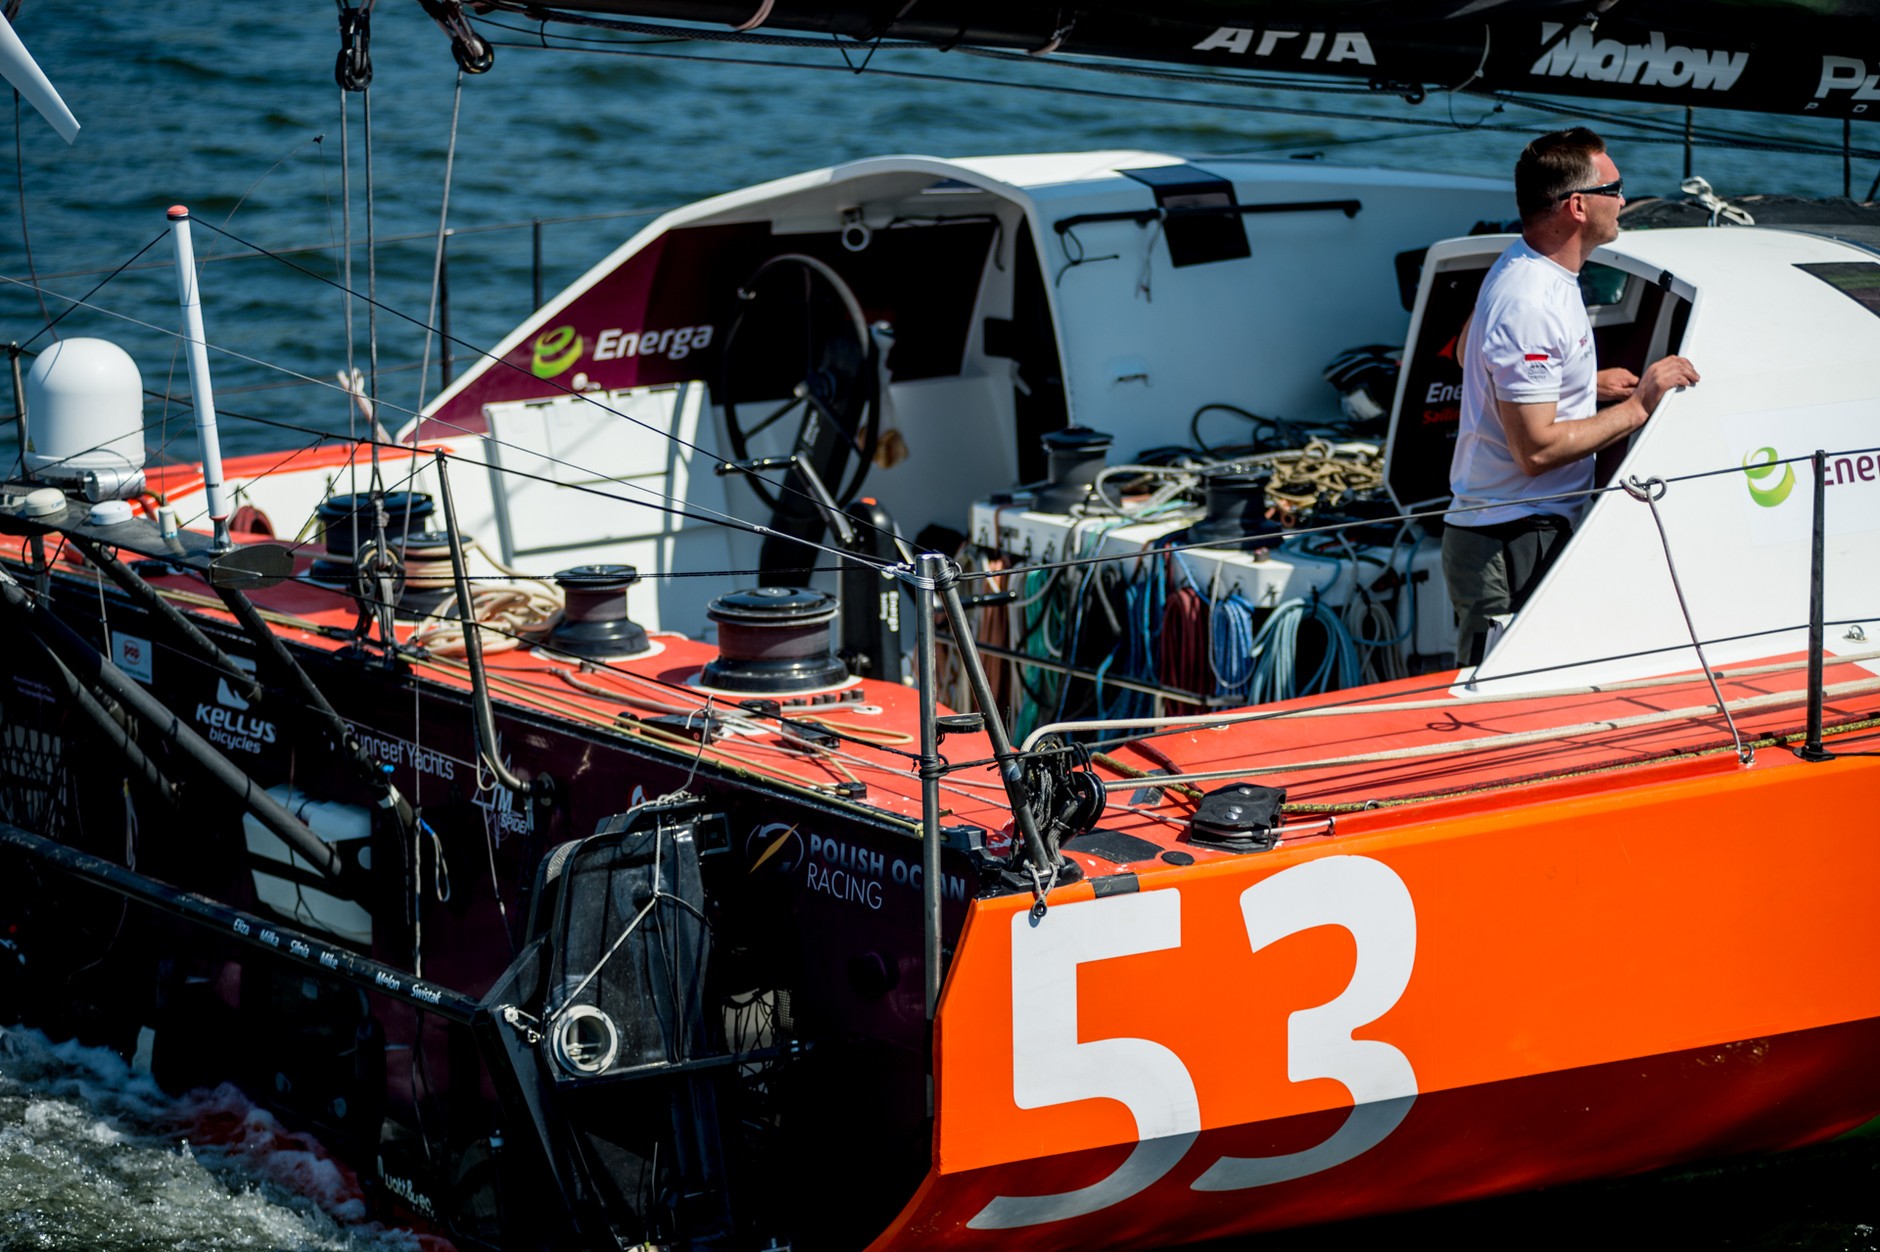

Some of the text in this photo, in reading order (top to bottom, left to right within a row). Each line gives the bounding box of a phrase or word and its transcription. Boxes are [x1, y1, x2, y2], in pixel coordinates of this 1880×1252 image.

[1530, 21, 1750, 91] Marlow
[592, 324, 714, 362] Energa
[209, 727, 262, 754] bicycles
[405, 740, 455, 780] Yachts
[807, 862, 883, 910] RACING
[810, 833, 966, 903] POLISH OCAN
[965, 855, 1419, 1230] 53
